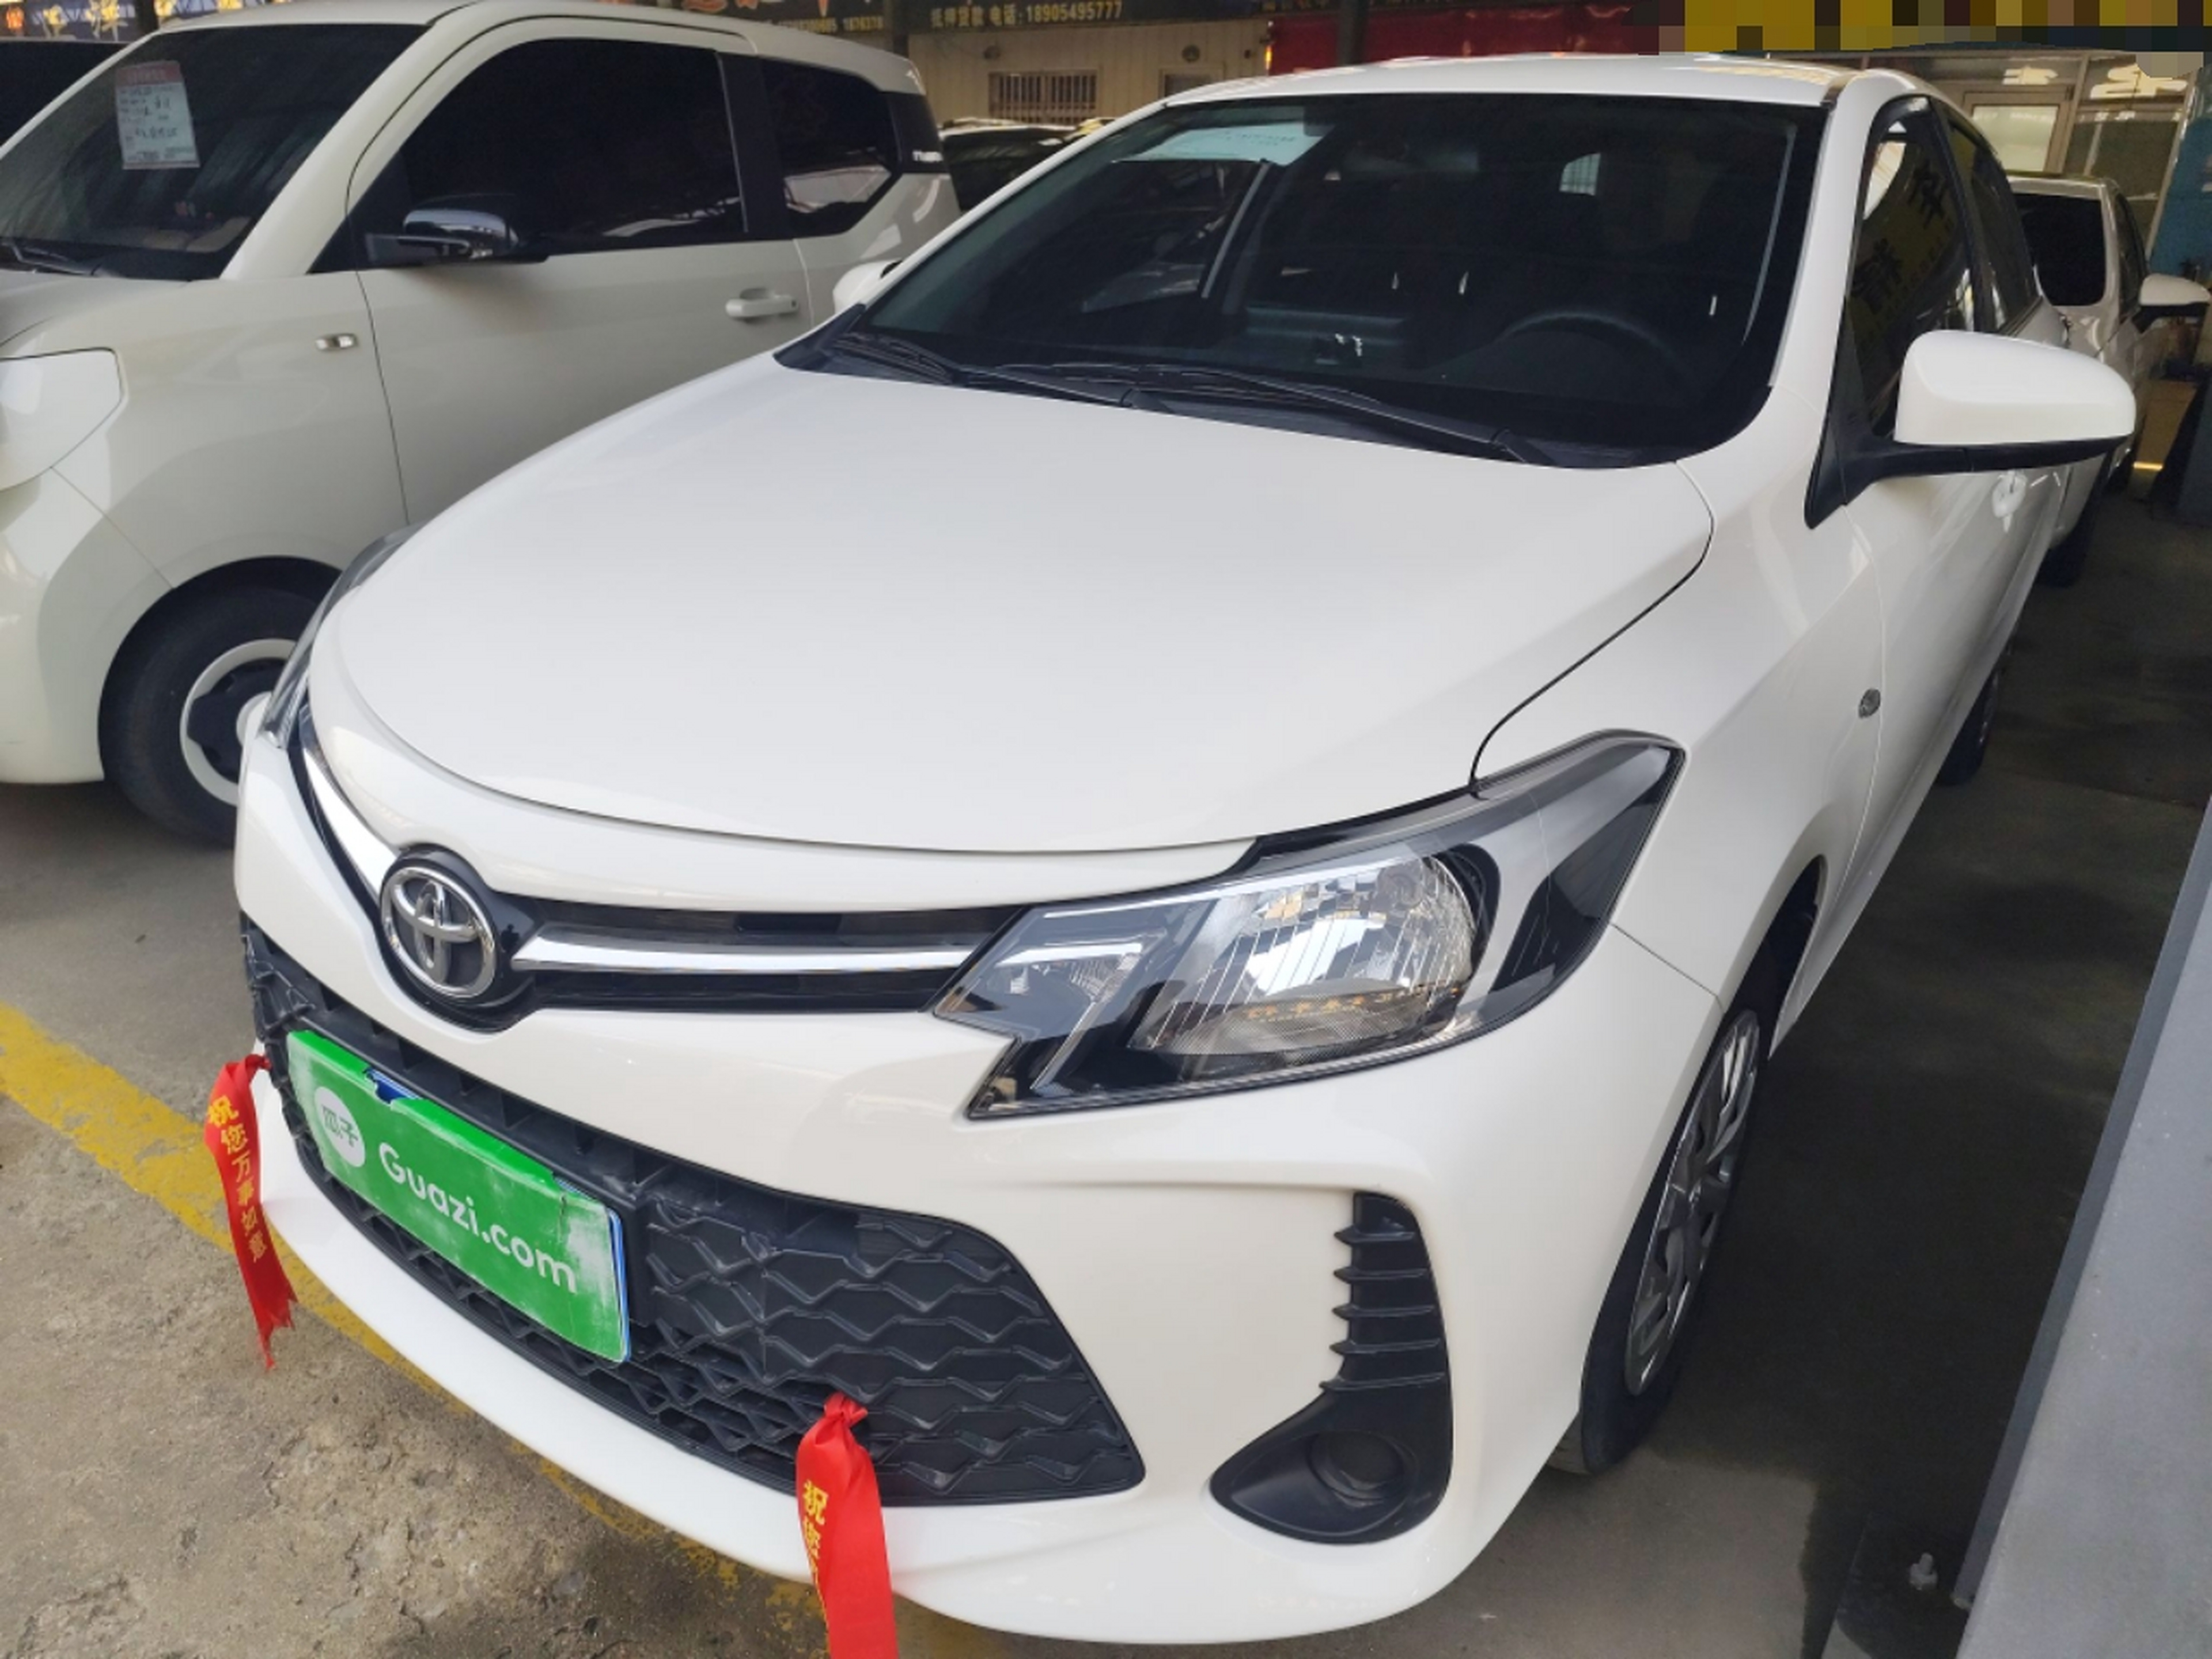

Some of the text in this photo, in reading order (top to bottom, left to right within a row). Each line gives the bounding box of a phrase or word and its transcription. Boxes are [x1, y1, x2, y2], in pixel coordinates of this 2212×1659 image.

[207, 1095, 267, 1263] 祝您万事如意
[321, 1104, 358, 1147] 瓜子
[378, 1142, 577, 1294] Guazi.com
